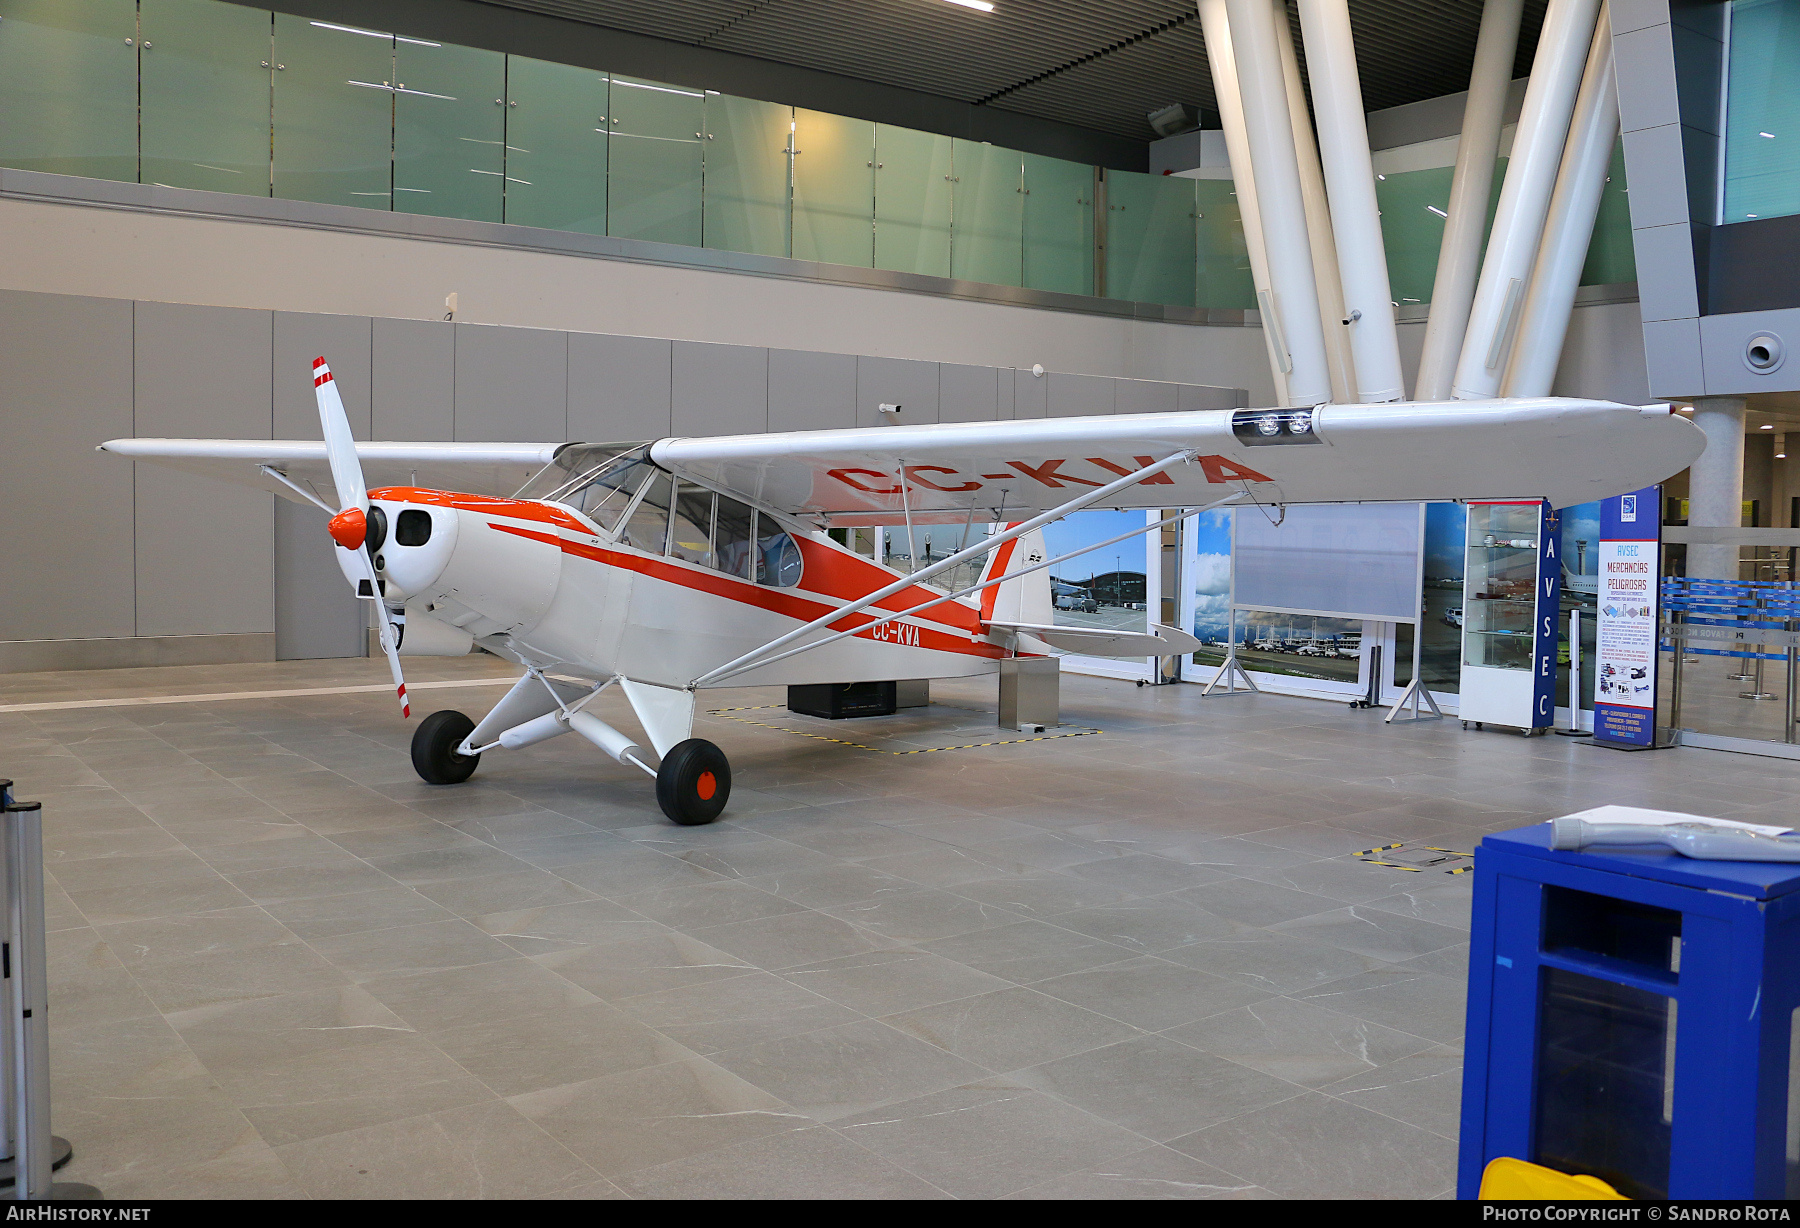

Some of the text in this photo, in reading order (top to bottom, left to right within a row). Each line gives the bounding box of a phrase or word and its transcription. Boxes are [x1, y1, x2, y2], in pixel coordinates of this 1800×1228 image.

[827, 454, 1275, 494] CC-KWA
[1617, 545, 1639, 557] AVSEC
[1607, 561, 1649, 574] MERCANCÍAS
[1607, 578, 1647, 591] PELIGROSAS
[873, 618, 920, 647] CC-KWA
[1540, 538, 1555, 716] AVSEC
